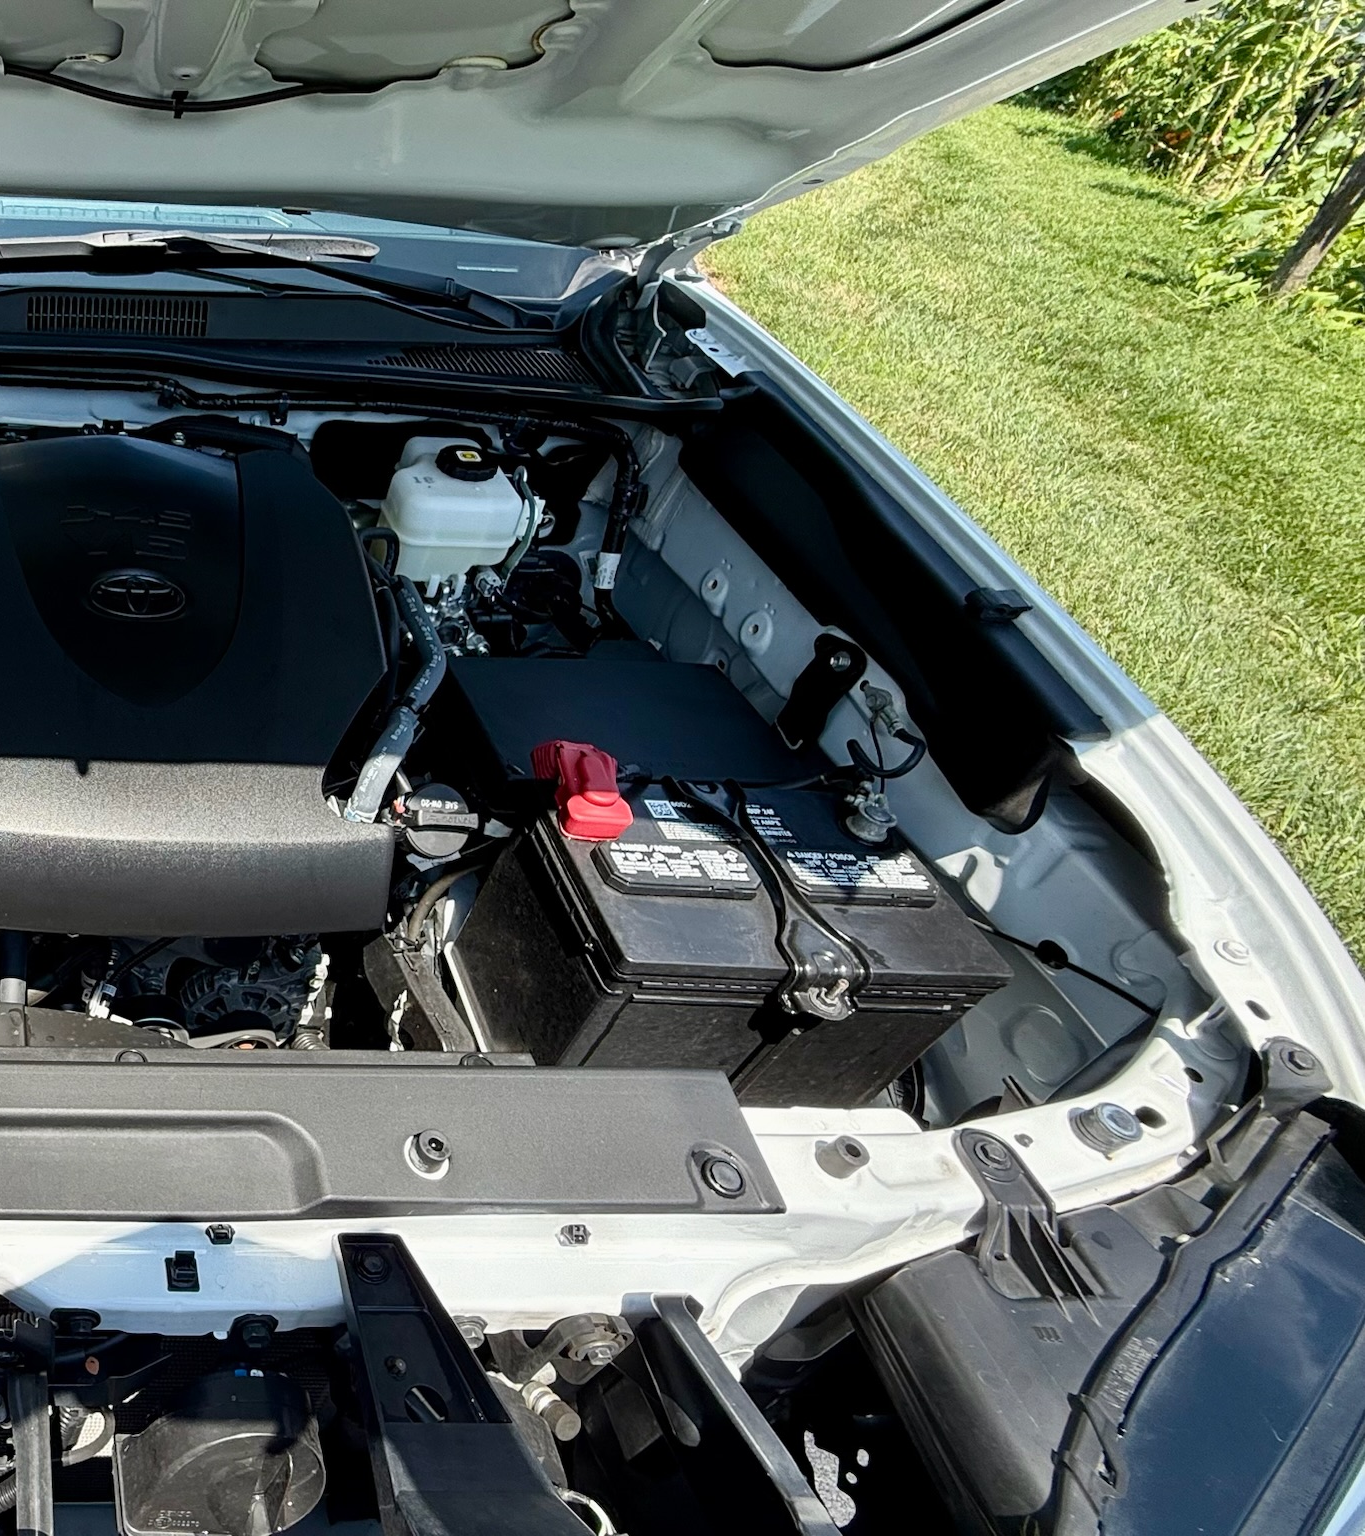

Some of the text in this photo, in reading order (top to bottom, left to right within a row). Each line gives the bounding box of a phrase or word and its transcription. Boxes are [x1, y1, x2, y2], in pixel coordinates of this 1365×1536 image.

[445, 801, 459, 810] SAE
[794, 851, 824, 859] DANGER
[828, 853, 857, 861] POISON
